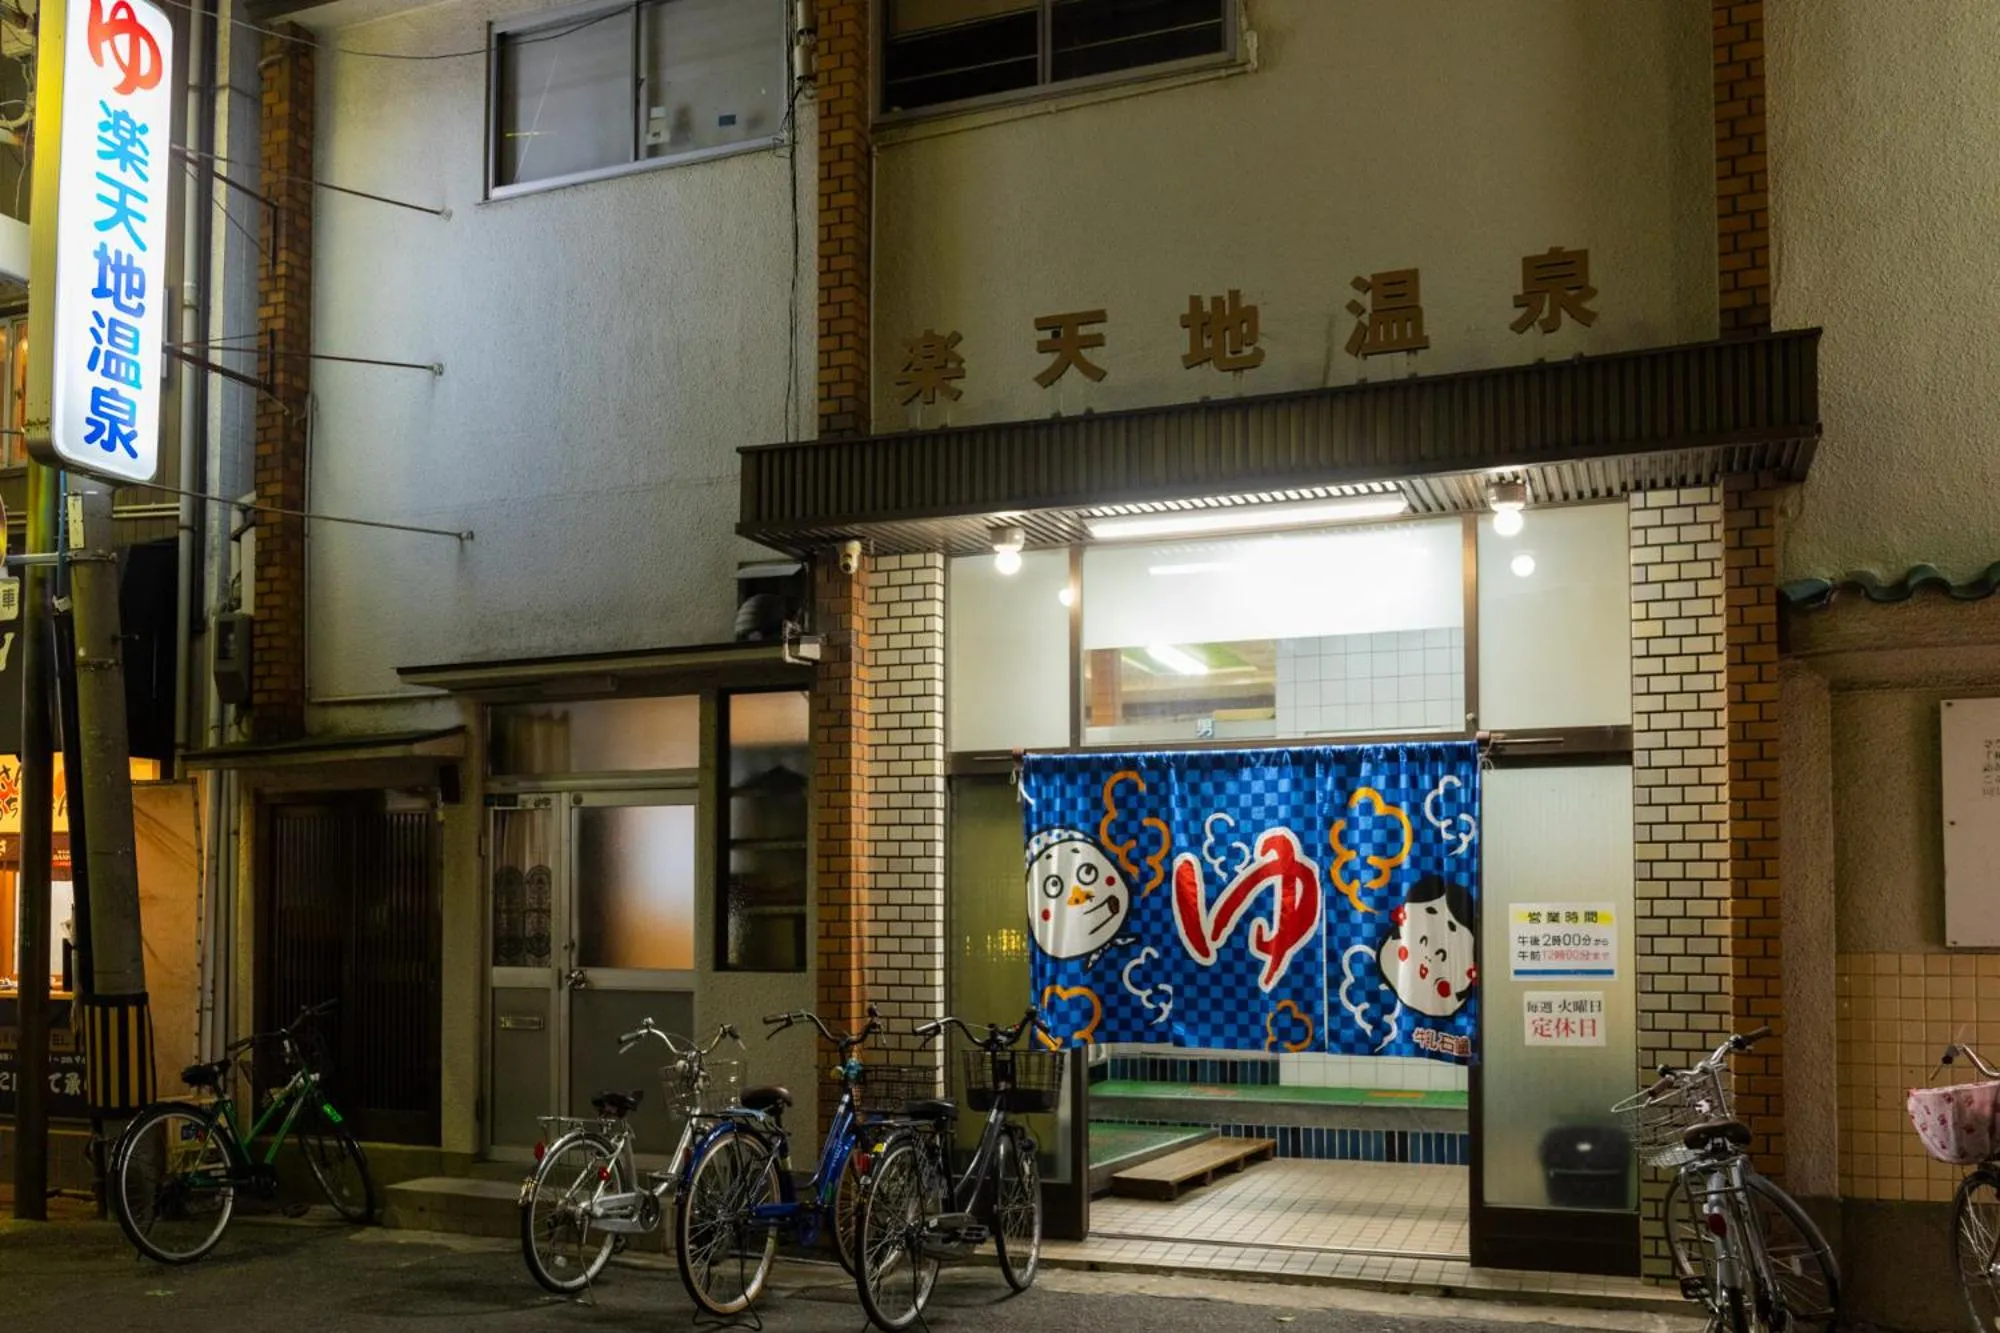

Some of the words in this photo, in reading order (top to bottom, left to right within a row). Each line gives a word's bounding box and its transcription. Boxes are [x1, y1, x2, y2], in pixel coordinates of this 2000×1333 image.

[87, 0, 163, 96] ゆ
[84, 99, 150, 460] 楽天地温泉
[895, 246, 1600, 406] 楽天地温泉
[1172, 826, 1322, 993] ゆ
[1527, 910, 1598, 924] 営業時間
[1517, 932, 1609, 947] 午後2時00分から
[1527, 1000, 1553, 1014] 毎週
[1557, 999, 1602, 1014] 火曜日
[1531, 1017, 1597, 1039] 定休日
